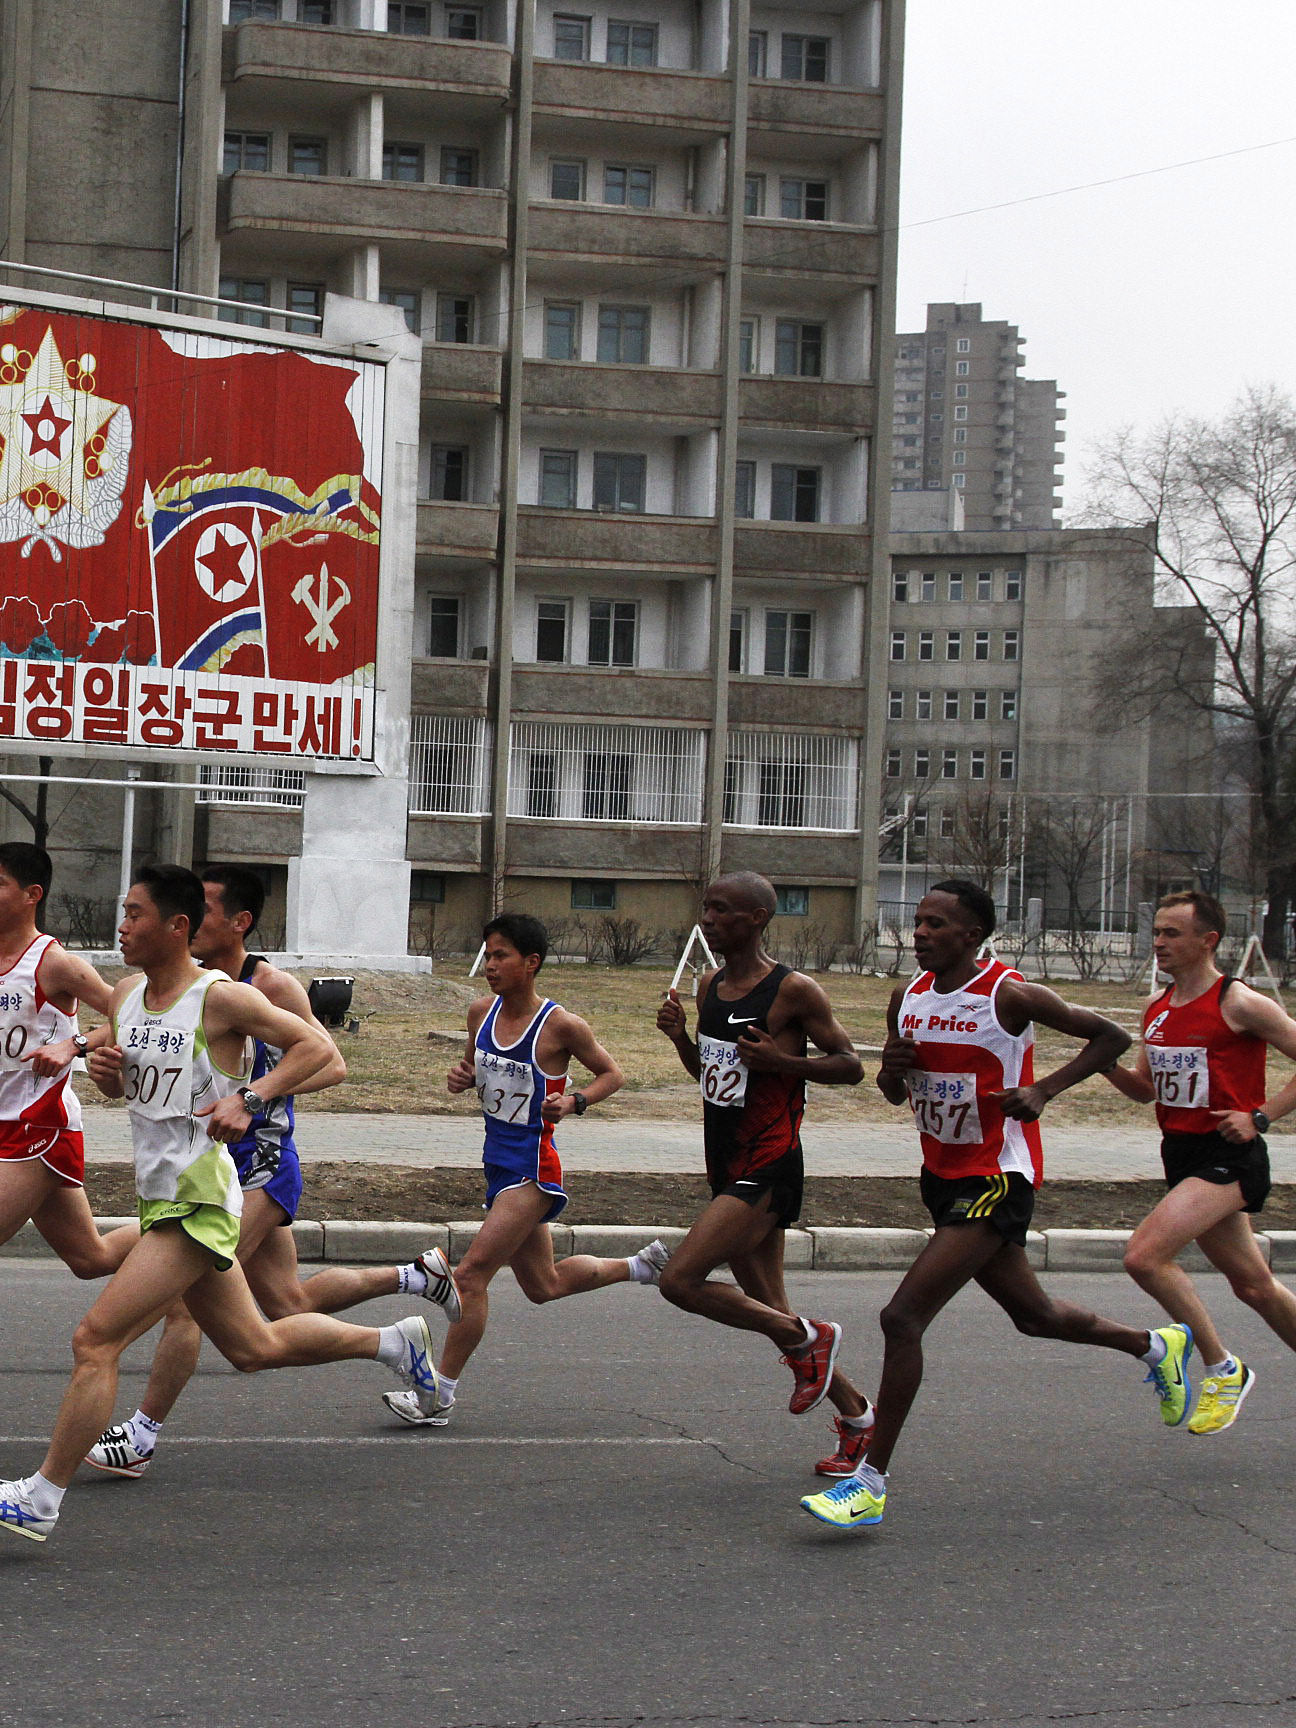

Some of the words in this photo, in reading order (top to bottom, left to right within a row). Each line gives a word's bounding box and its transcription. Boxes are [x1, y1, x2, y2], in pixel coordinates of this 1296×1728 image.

[126, 1027, 185, 1055] 조선-평양
[901, 1014, 923, 1029] Mr
[927, 1015, 978, 1032] Price
[125, 1063, 184, 1108] 307
[477, 1082, 530, 1123] 437
[915, 1099, 972, 1139] 757
